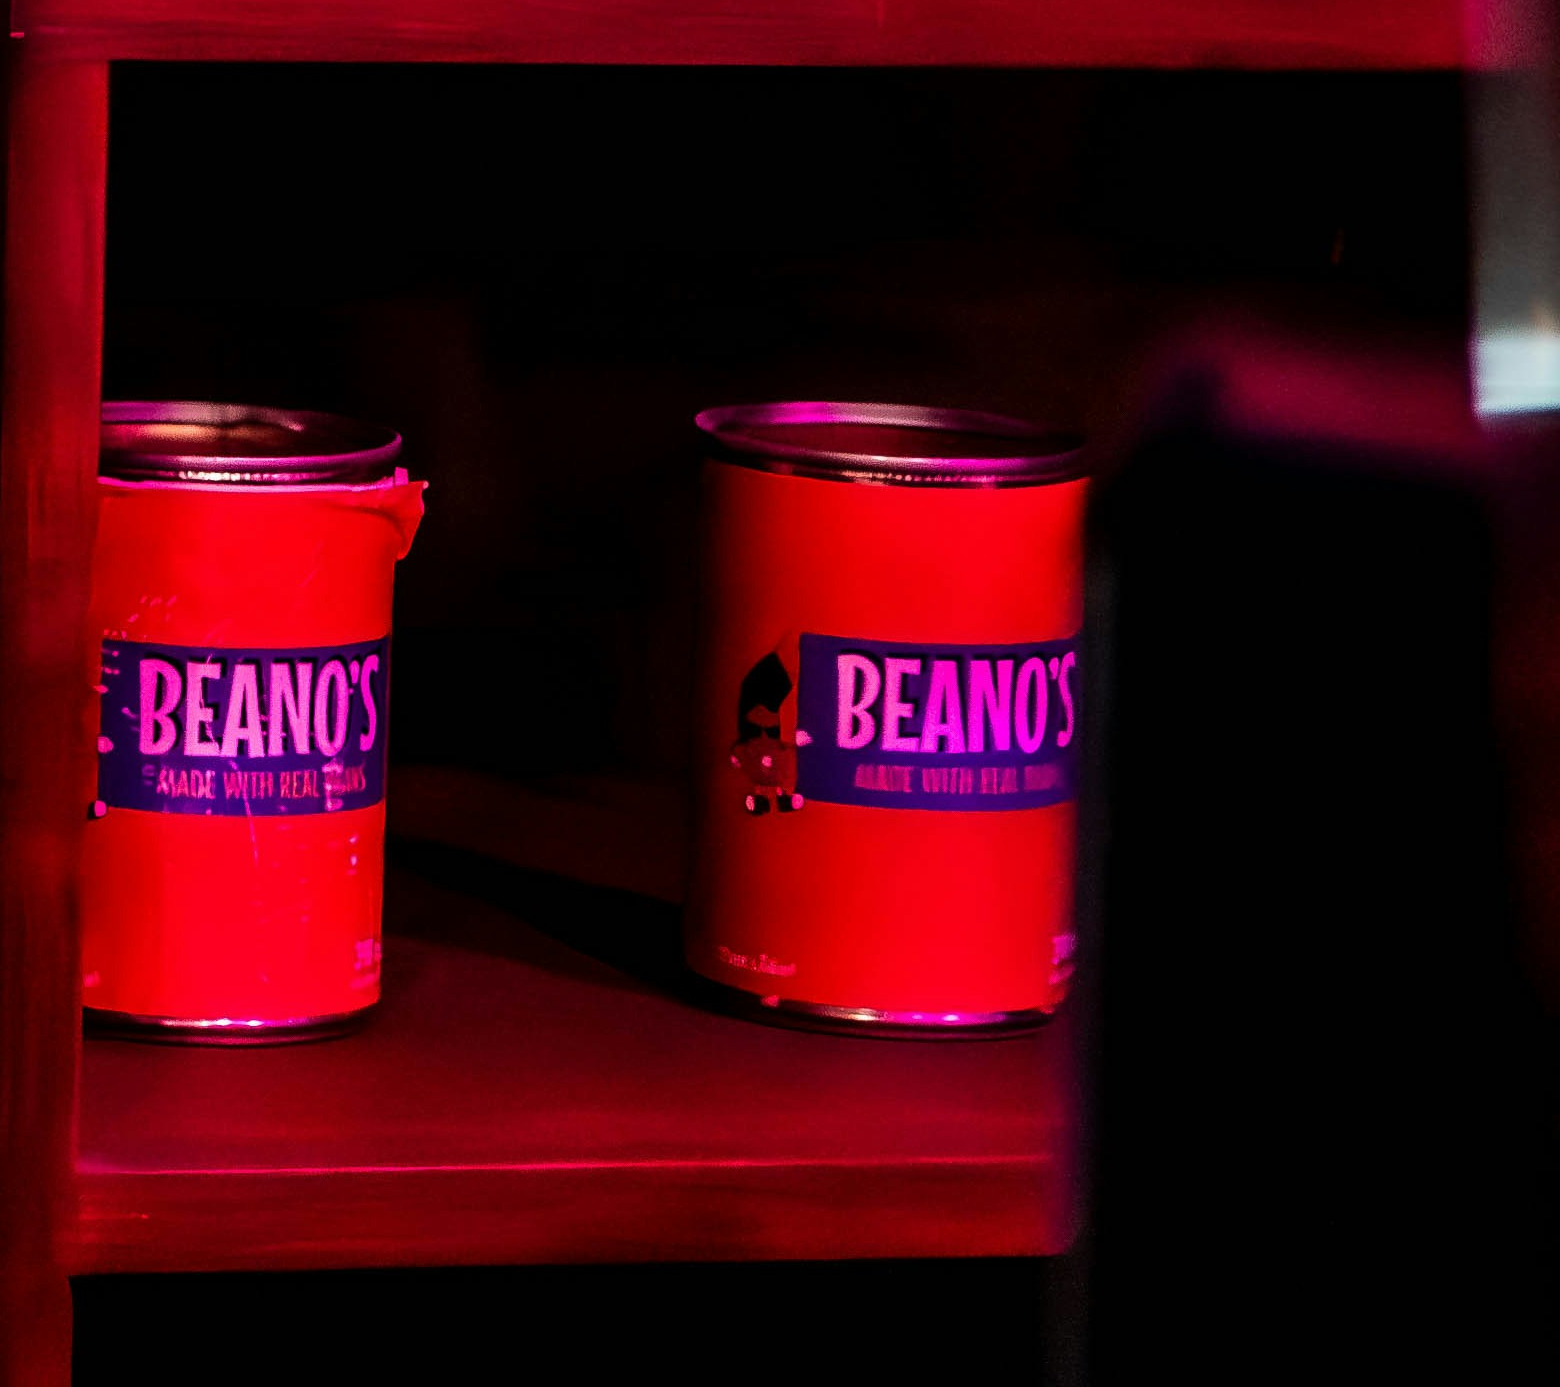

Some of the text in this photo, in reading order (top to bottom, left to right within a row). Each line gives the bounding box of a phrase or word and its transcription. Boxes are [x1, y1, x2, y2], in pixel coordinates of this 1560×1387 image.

[139, 654, 380, 758] BEANO'S
[836, 651, 1076, 754] BEANO'S
[156, 768, 216, 800] MADE
[223, 770, 274, 800] WITH
[279, 769, 319, 799] REAL
